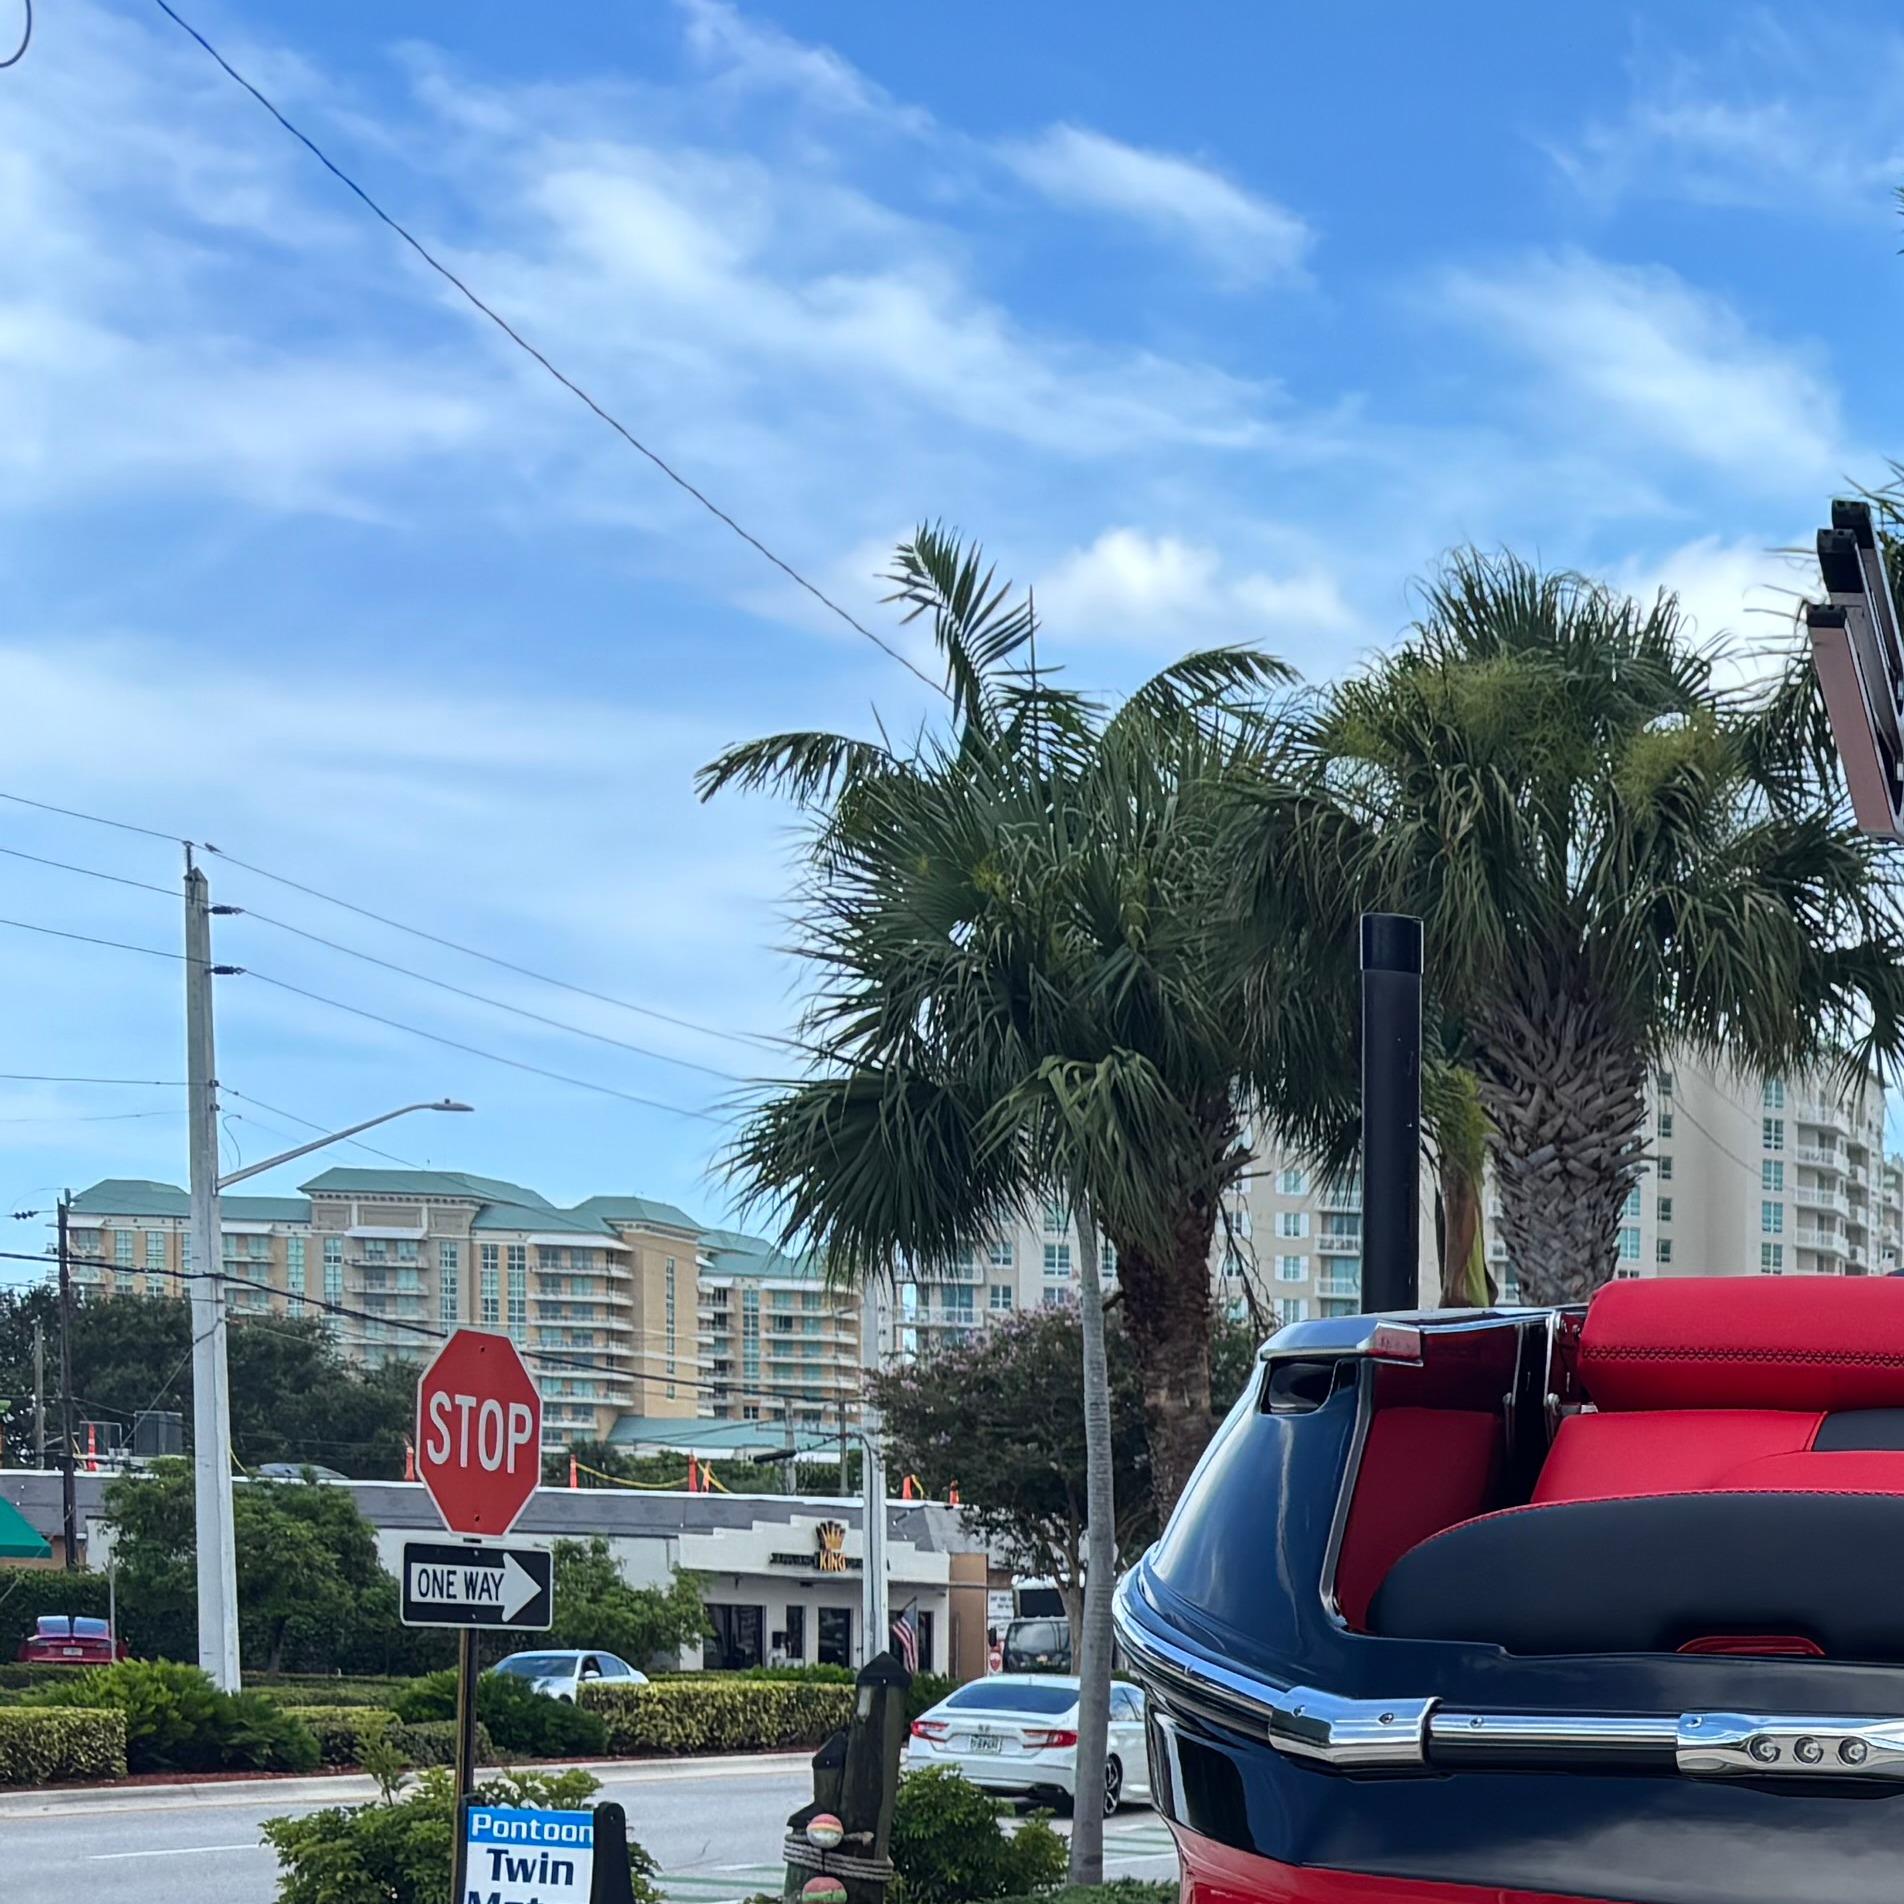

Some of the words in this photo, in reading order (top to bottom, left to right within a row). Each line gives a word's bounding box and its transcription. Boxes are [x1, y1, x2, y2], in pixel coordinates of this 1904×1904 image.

[426, 1390, 533, 1474] STOP
[417, 1567, 457, 1600] ONE
[463, 1570, 504, 1602] WAY
[472, 1814, 593, 1843] Pontoon
[487, 1848, 574, 1886] Twin
